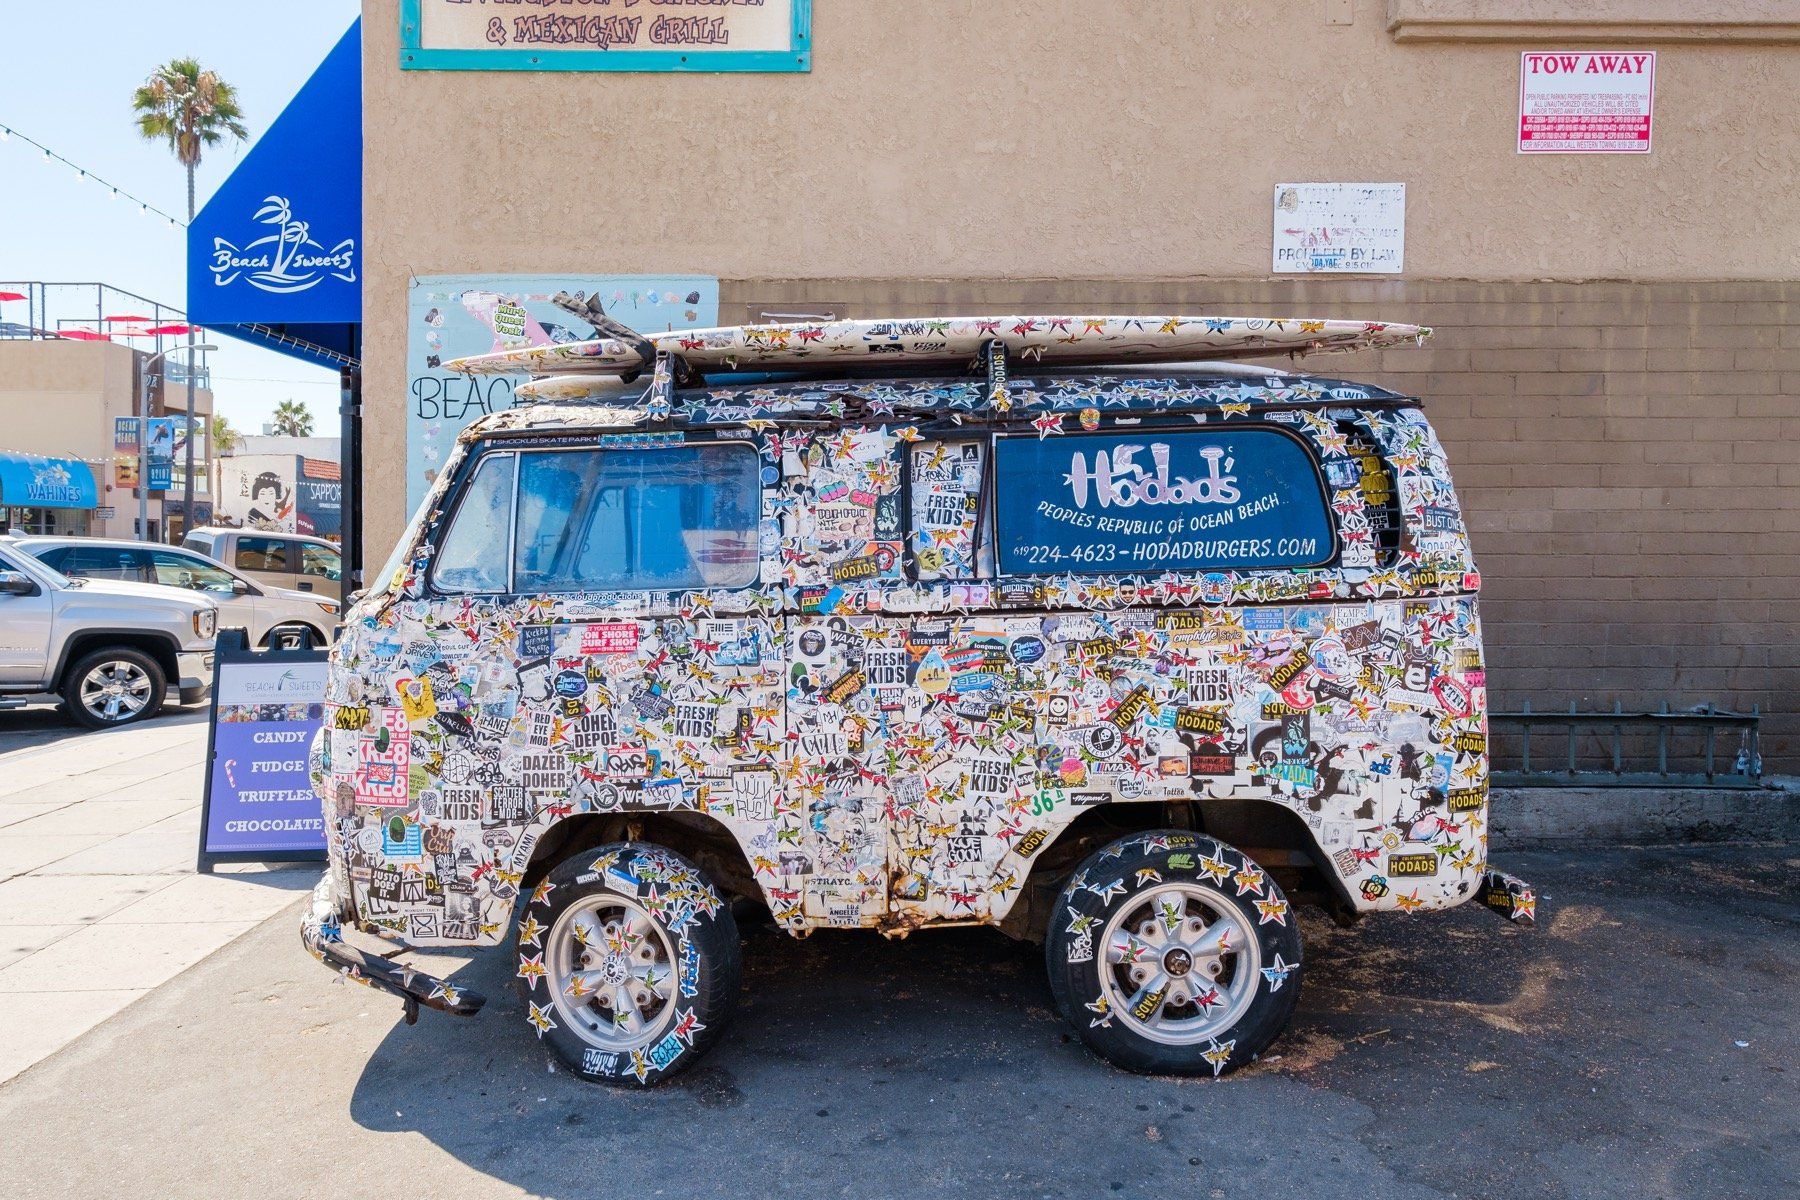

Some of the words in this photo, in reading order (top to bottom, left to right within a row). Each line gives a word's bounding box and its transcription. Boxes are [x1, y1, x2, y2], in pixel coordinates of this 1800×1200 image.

[486, 16, 506, 45] &
[514, 15, 642, 50] MEXICAN
[649, 15, 729, 45] GRILL
[1528, 56, 1580, 74] TOW
[1585, 56, 1647, 74] AWAY
[213, 249, 268, 269] Beach
[498, 305, 526, 318] Murk
[495, 313, 526, 327] Quest
[494, 324, 524, 337] Vosk
[412, 375, 525, 420] BEAC
[117, 420, 138, 432] OCEAN
[117, 432, 138, 444] BEACH
[539, 437, 568, 445] SKATE
[568, 436, 592, 444] PARK
[26, 482, 81, 503] WAHINES
[927, 494, 965, 509] FRESH
[926, 509, 963, 526] KIDS
[1037, 501, 1095, 529] PEOPLES
[1096, 516, 1163, 535] REPUBLIC
[1168, 518, 1185, 533] OF
[1190, 510, 1234, 530] OCEAN
[1239, 493, 1280, 520] BEACH
[1426, 515, 1446, 528] BUST
[1013, 545, 1029, 558] 619
[1029, 543, 1116, 564] 224-4623
[1132, 538, 1317, 561] HODADBURGERS.COM
[834, 563, 877, 581] HODADS
[1413, 573, 1439, 585] HODA
[525, 627, 549, 639] KICKED
[601, 631, 634, 639] SHORE
[582, 639, 608, 647] SURF
[610, 638, 636, 647] SHOP
[974, 643, 1005, 651] longmont
[606, 652, 628, 664] Good
[868, 652, 905, 666] FRESH
[1456, 656, 1481, 668] HODAD
[609, 660, 638, 677] Vibes
[868, 667, 906, 684] KIDS
[1270, 651, 1308, 689] HODADS
[1189, 669, 1228, 684] FRESH
[245, 682, 274, 691] BEACH
[289, 681, 322, 691] SWEETS
[1190, 685, 1228, 702] KIDS
[534, 713, 549, 724] RED
[677, 705, 713, 719] FRESH
[1048, 715, 1067, 723] zero
[533, 725, 548, 735] EYE
[676, 720, 712, 738] KIDS
[1177, 714, 1222, 732] HODADS
[253, 731, 307, 744] CANDY
[529, 736, 548, 746] MOB
[1456, 738, 1485, 751] HODADS
[251, 761, 304, 773] FUDGE
[522, 755, 565, 770] DAZER
[972, 759, 1011, 775] FRESH
[522, 773, 566, 788] DOHER
[970, 776, 1008, 793] KIDS
[238, 790, 313, 802] TRUFFLES
[443, 789, 479, 803] FRESH
[494, 786, 523, 798] SCATTER
[494, 798, 523, 809] TERROR
[1449, 792, 1483, 808] HODADS
[443, 804, 479, 820] KIDS
[225, 818, 322, 832] CHOCOLATE
[514, 834, 536, 868] MYAMI
[1390, 859, 1435, 873] HODADS
[373, 870, 400, 883] JUSTO
[374, 880, 396, 891] DOES
